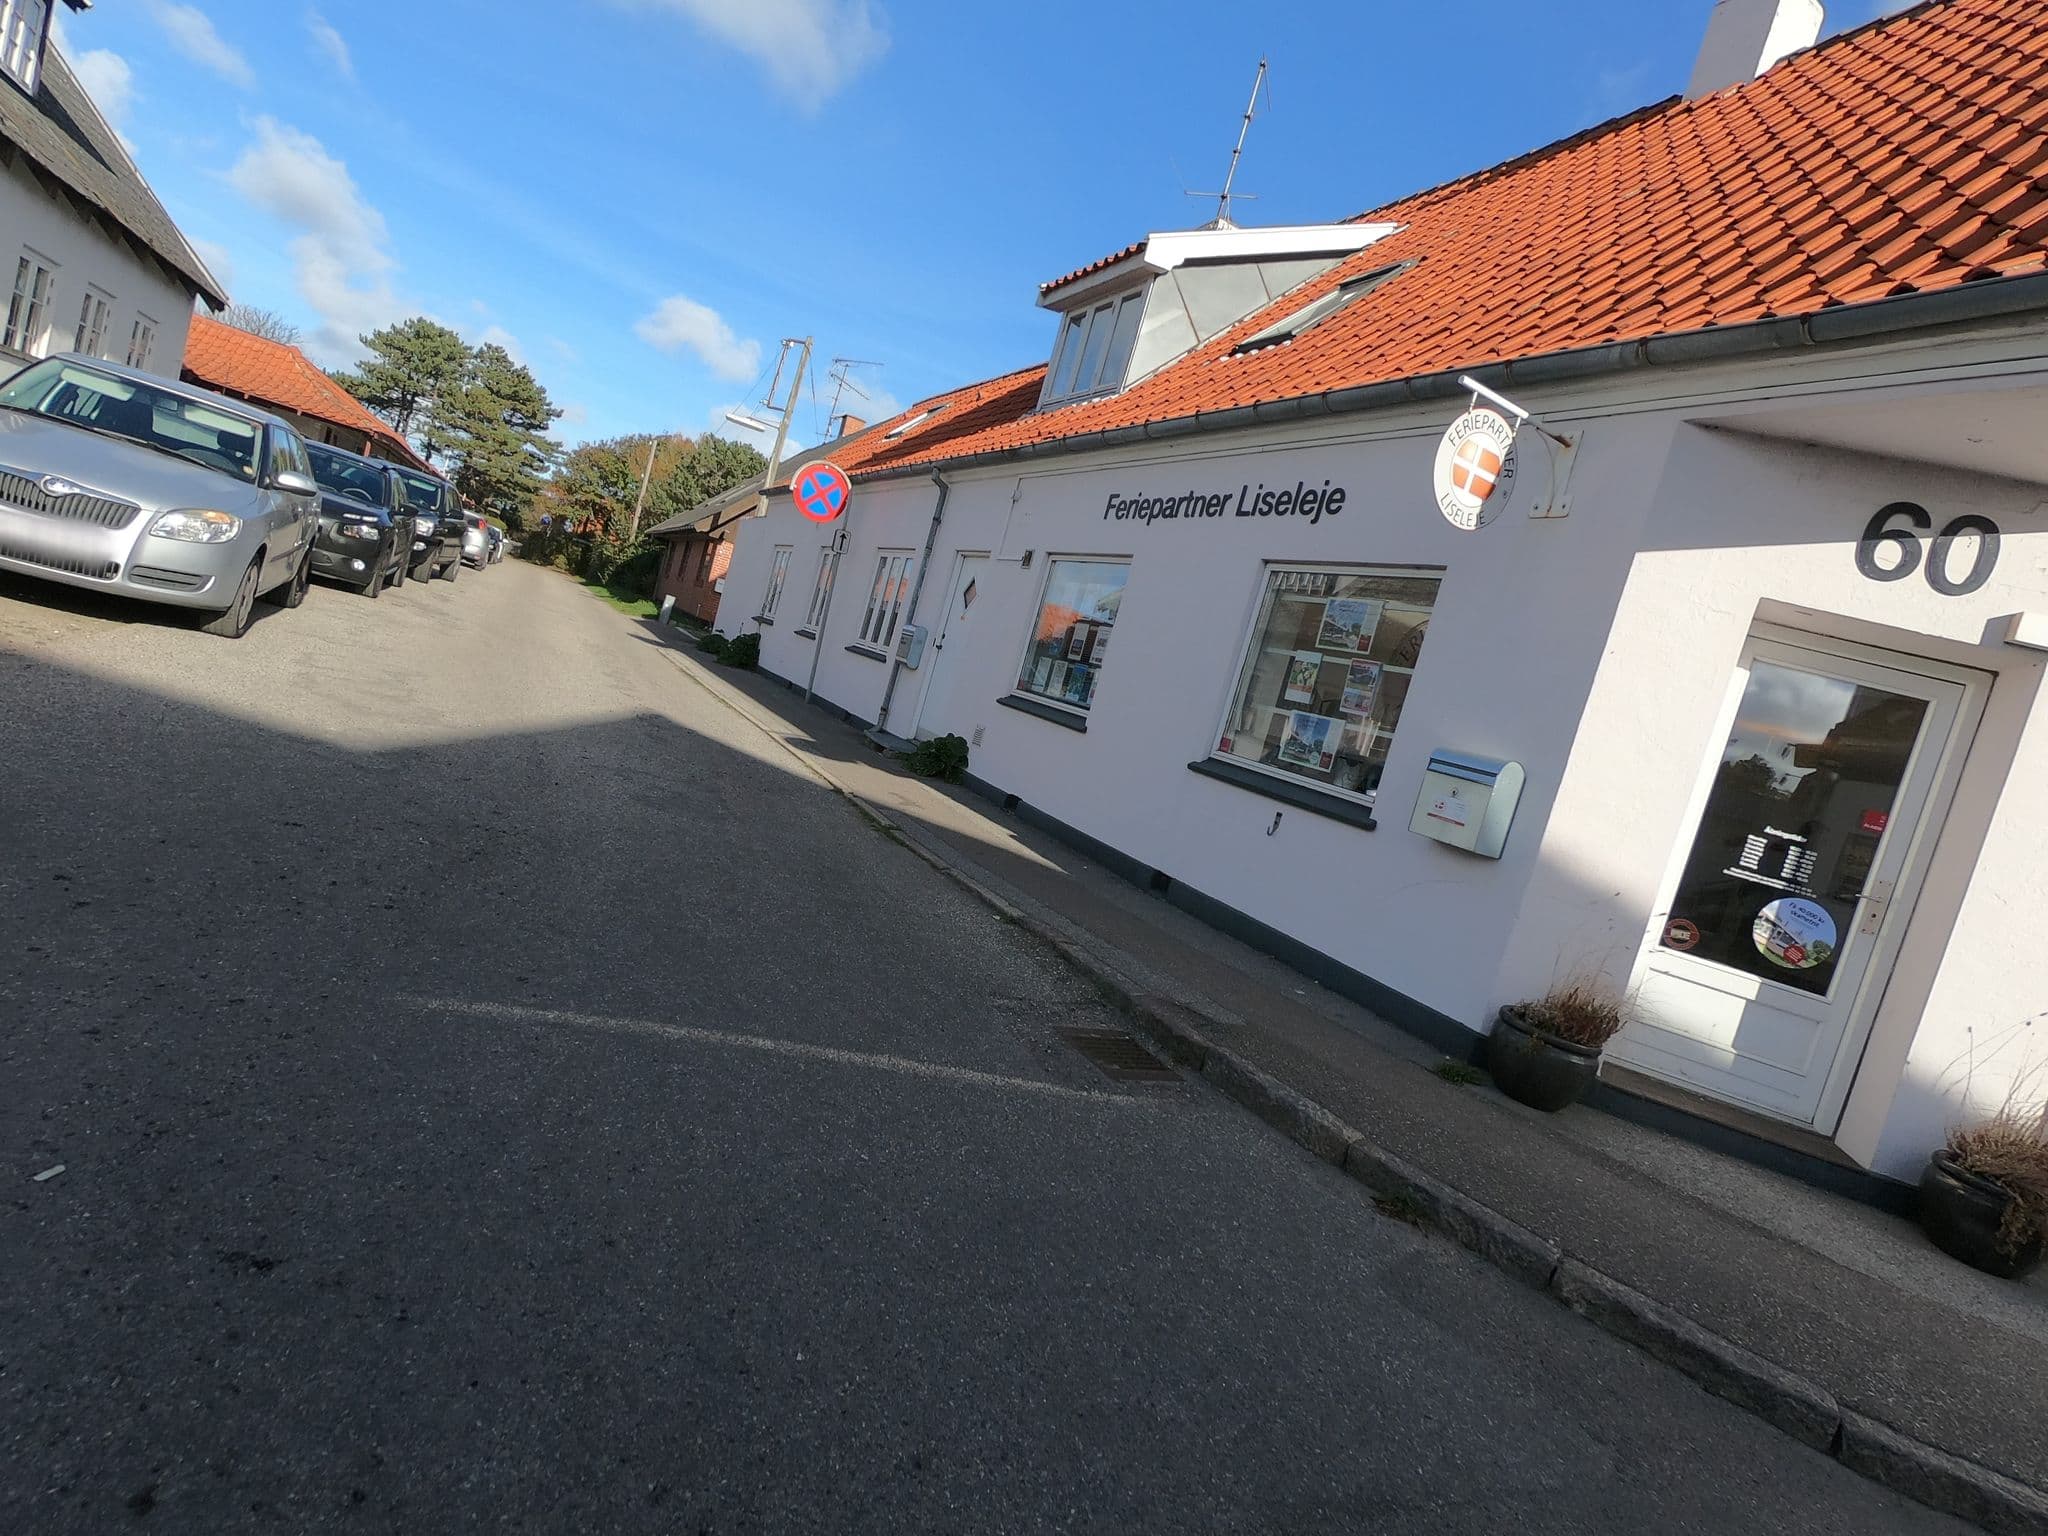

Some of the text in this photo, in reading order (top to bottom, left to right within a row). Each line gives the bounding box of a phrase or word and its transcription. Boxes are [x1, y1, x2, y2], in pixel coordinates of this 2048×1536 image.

[1448, 414, 1515, 479] FERIEPARTNER
[1103, 480, 1346, 526] Feriepartner Liseleje
[1440, 493, 1486, 528] LISELEJE
[1855, 501, 2000, 596] 60
